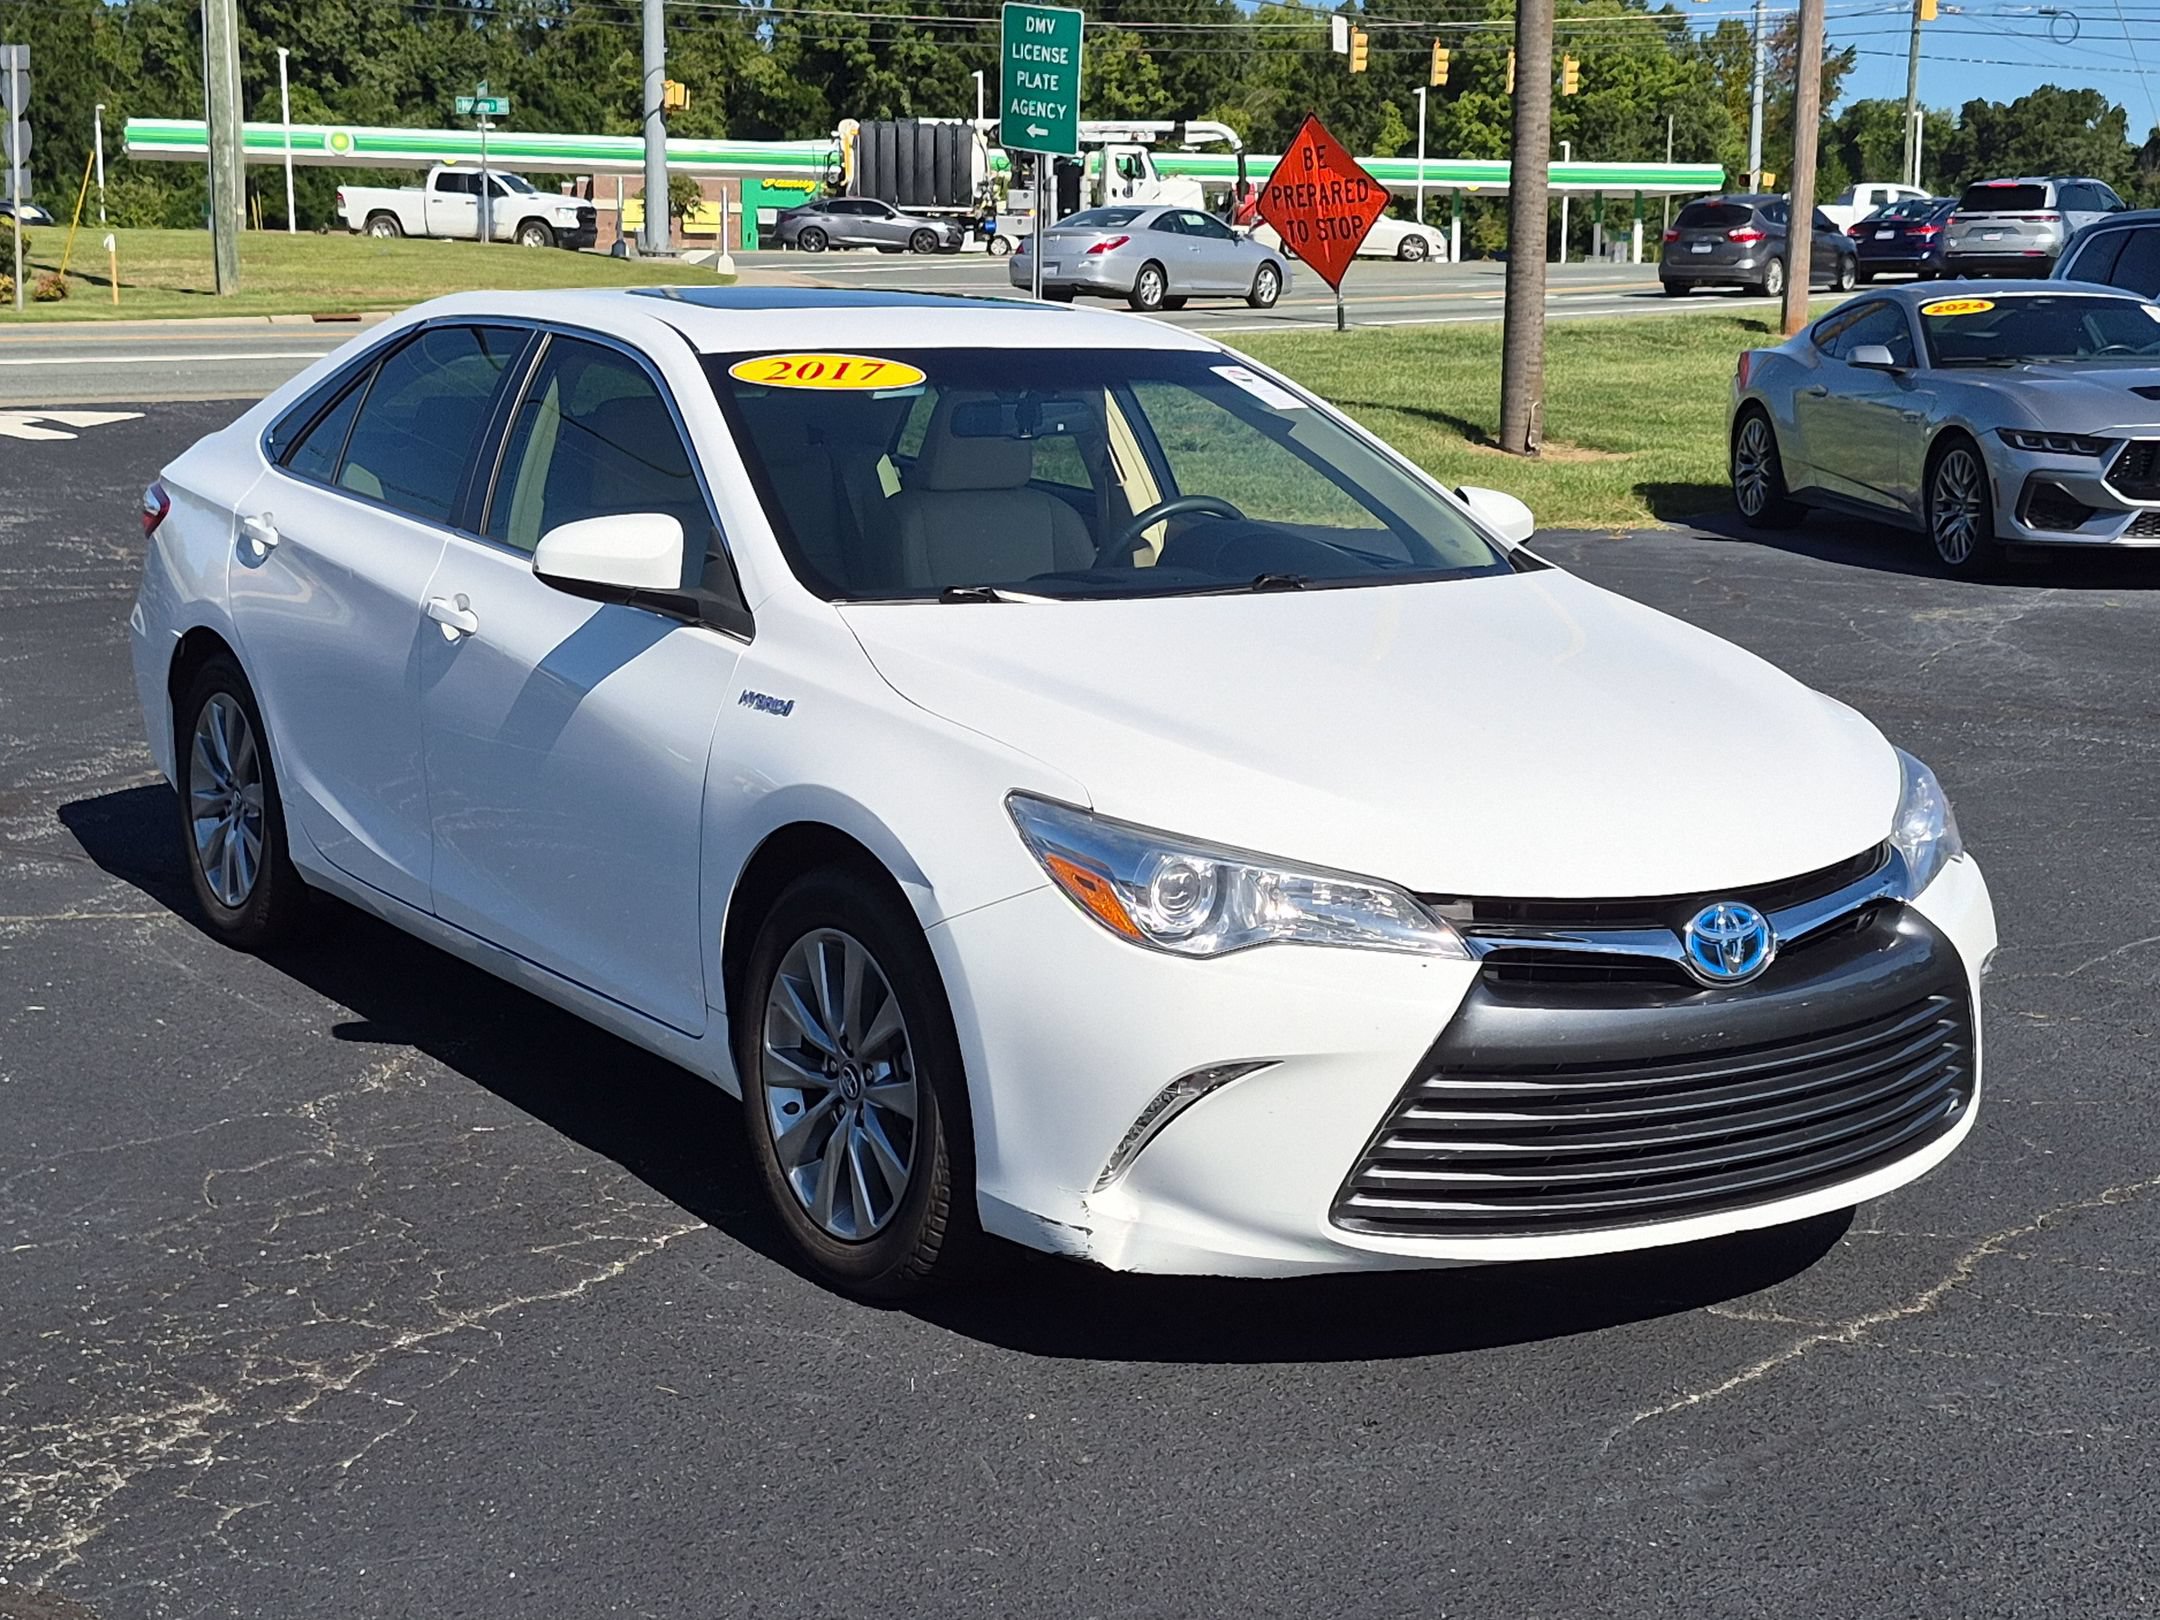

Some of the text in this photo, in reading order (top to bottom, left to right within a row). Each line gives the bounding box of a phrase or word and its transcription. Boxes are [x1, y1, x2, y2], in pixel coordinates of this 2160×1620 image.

[1025, 15, 1056, 35] DMV
[1012, 42, 1069, 65] LICENSE
[1016, 70, 1059, 91] PLATE
[1010, 97, 1067, 120] AGENCY
[1302, 144, 1329, 171] BE
[1271, 178, 1370, 210] PREPARED
[1286, 215, 1364, 244] TO STOP
[1932, 302, 1986, 313] 2024
[763, 361, 886, 381] 2017
